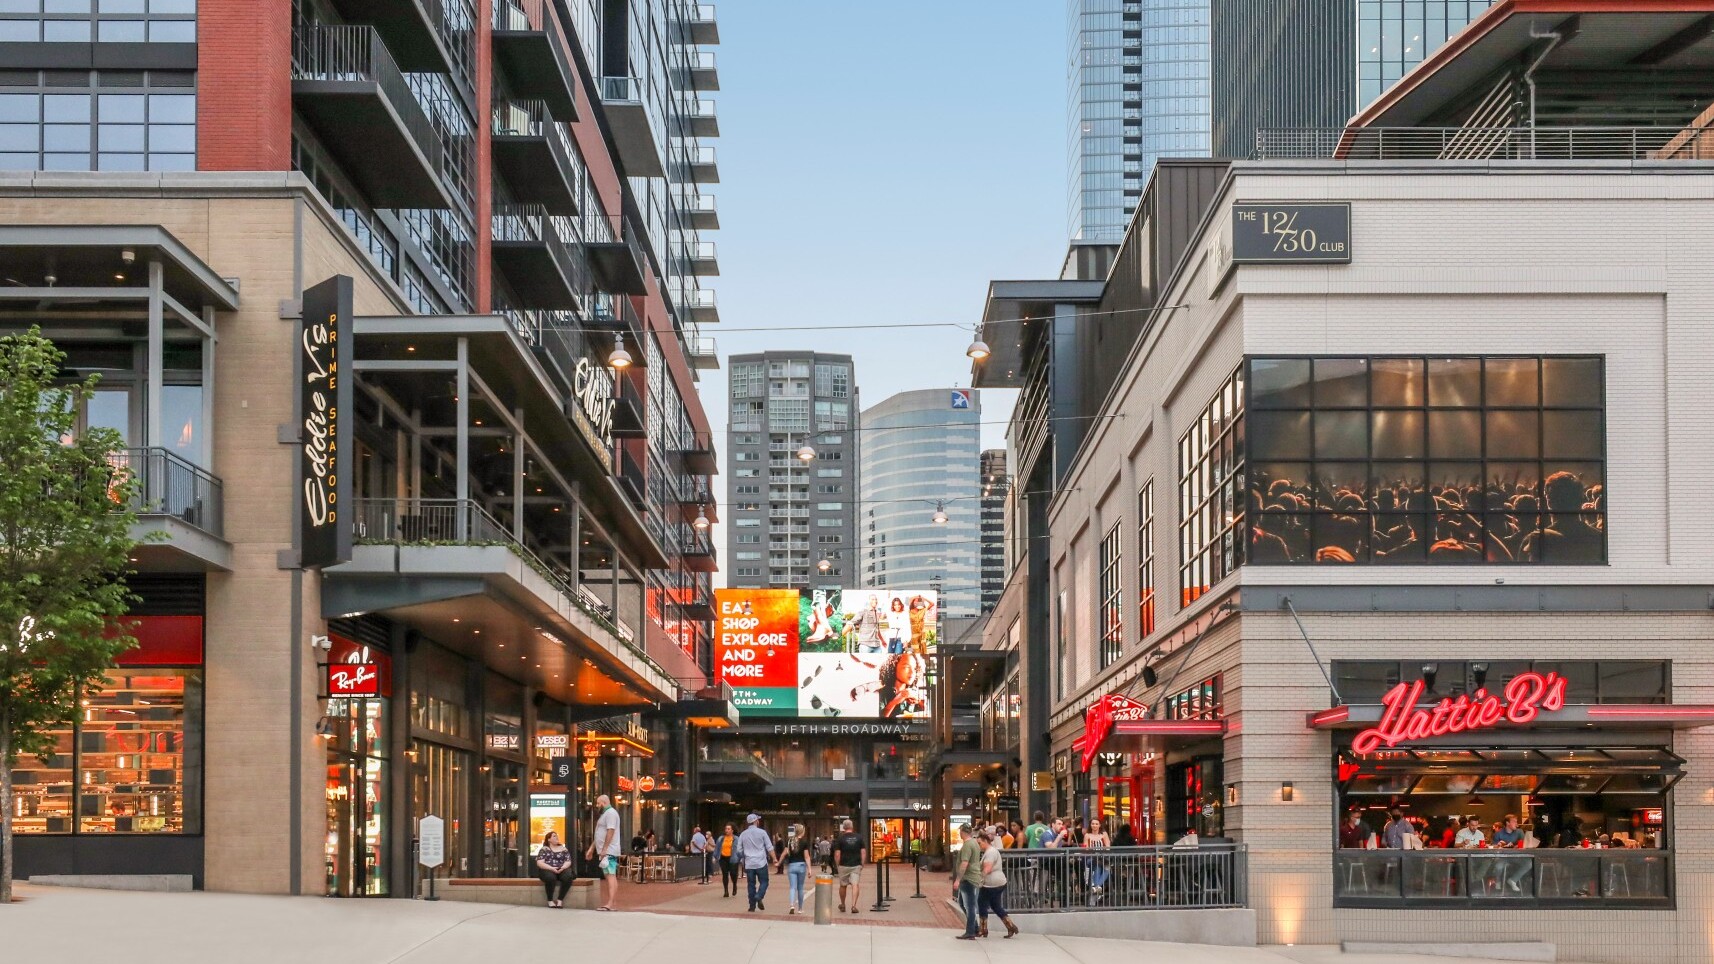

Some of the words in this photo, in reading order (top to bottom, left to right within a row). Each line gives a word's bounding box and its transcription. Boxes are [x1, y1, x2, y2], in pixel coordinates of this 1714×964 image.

[1238, 211, 1256, 221] THE
[1320, 242, 1344, 252] CLUB
[303, 323, 328, 383] V's
[329, 313, 337, 390] PRIME
[305, 392, 327, 526] Eddie
[328, 407, 337, 523] SEAFOOD
[331, 666, 376, 690] Ray-Ban
[722, 649, 755, 661] AND
[537, 736, 566, 745] VESEO
[1352, 679, 1505, 754] Hattie
[1504, 671, 1568, 723] B's
